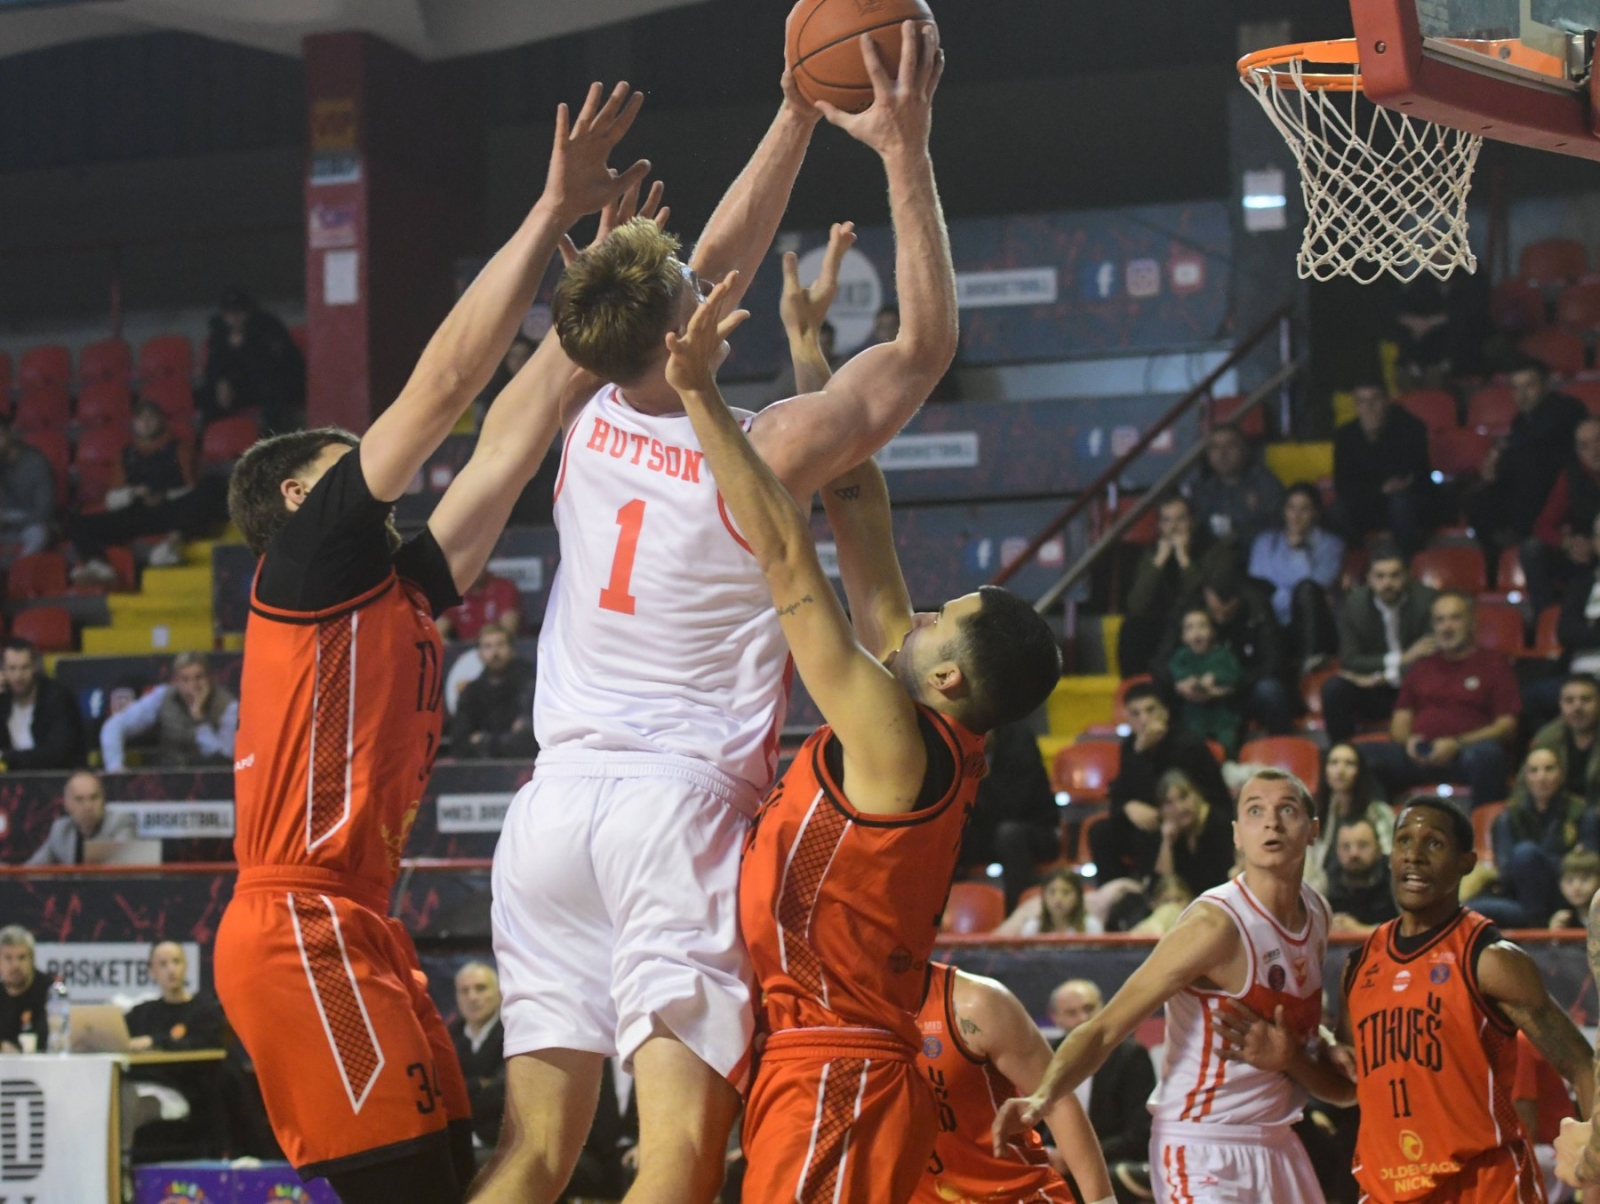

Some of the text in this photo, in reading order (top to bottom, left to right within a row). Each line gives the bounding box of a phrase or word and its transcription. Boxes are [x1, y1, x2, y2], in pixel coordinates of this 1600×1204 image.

[586, 416, 705, 484] HUTSON
[598, 498, 646, 616] 1
[47, 957, 192, 988] BASKETB
[1389, 1078, 1412, 1118] 11
